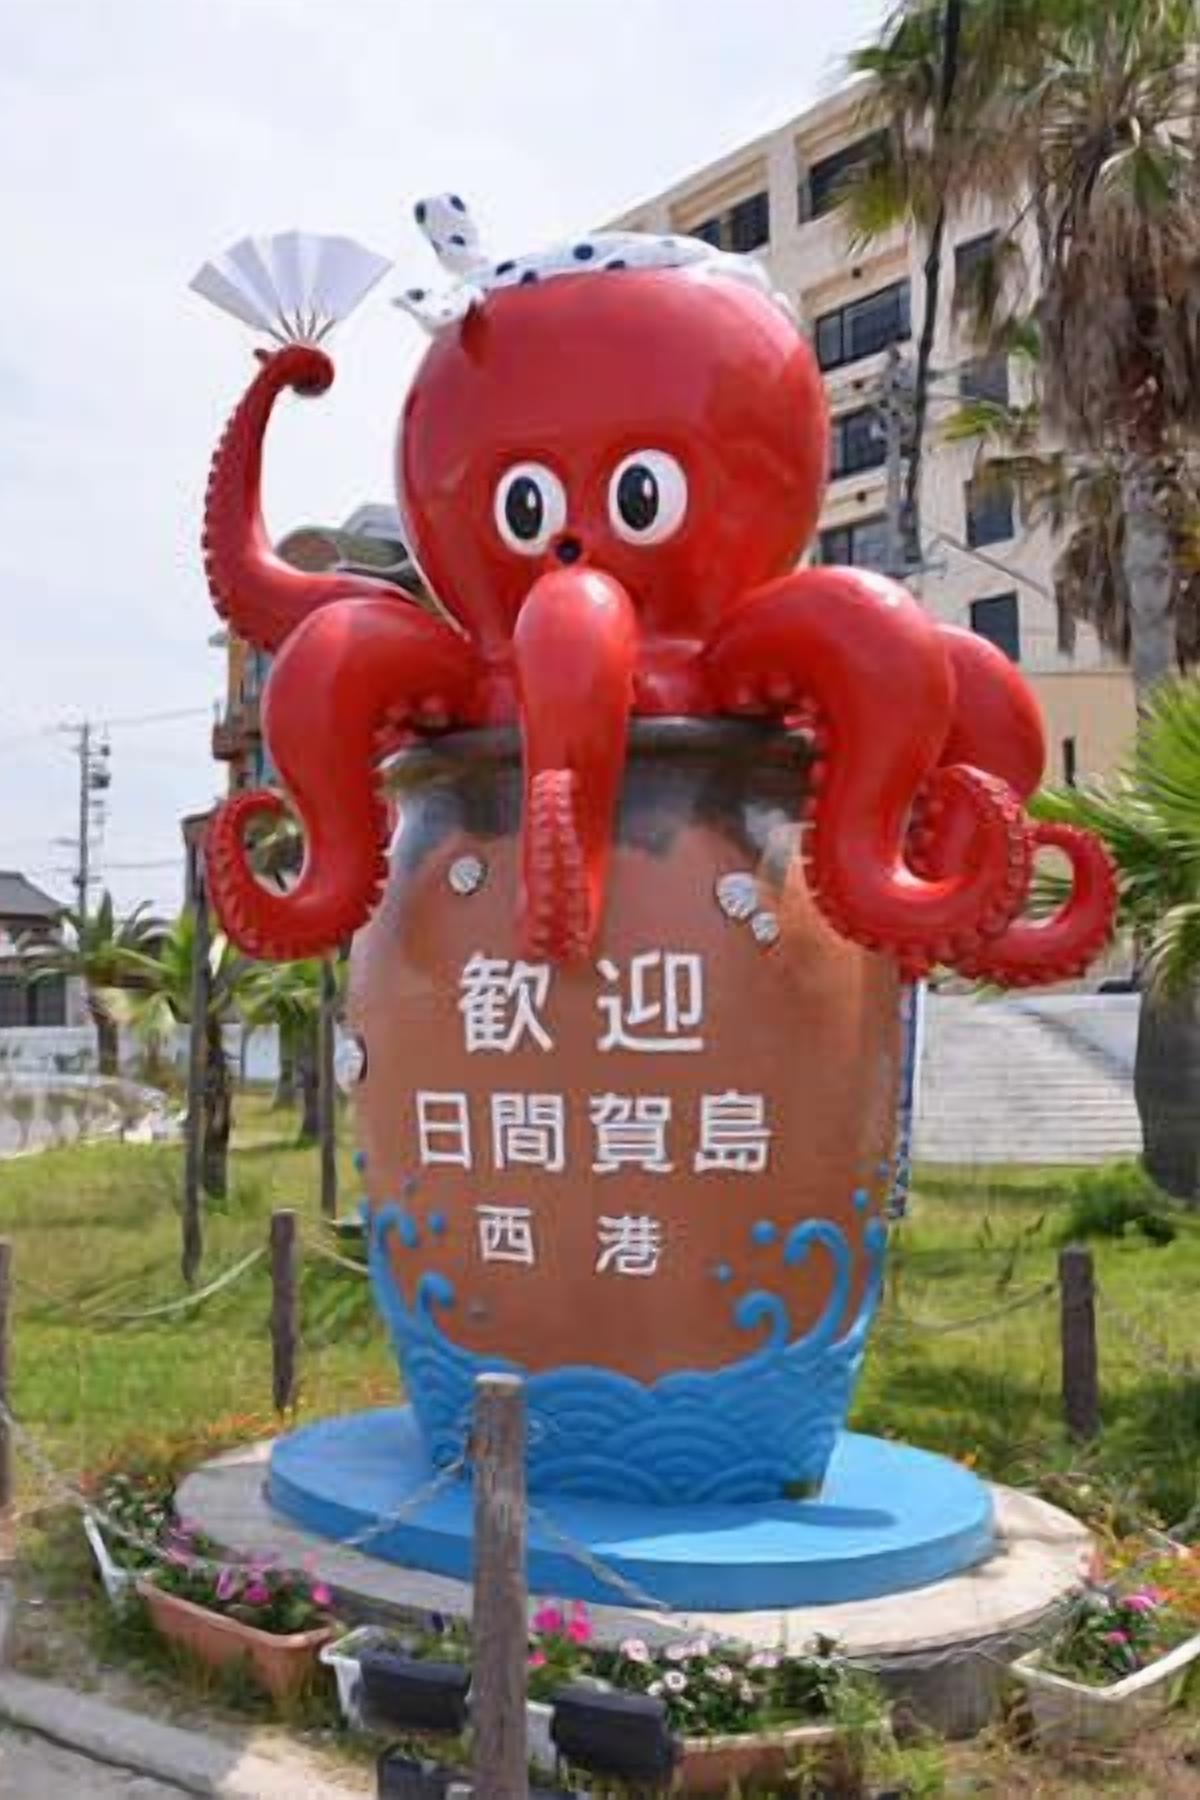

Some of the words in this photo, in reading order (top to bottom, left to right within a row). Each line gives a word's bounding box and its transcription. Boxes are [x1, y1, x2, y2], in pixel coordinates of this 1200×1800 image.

[458, 950, 704, 1053] 歓迎
[416, 1088, 772, 1173] 日間賀島
[476, 1204, 664, 1276] 西港
